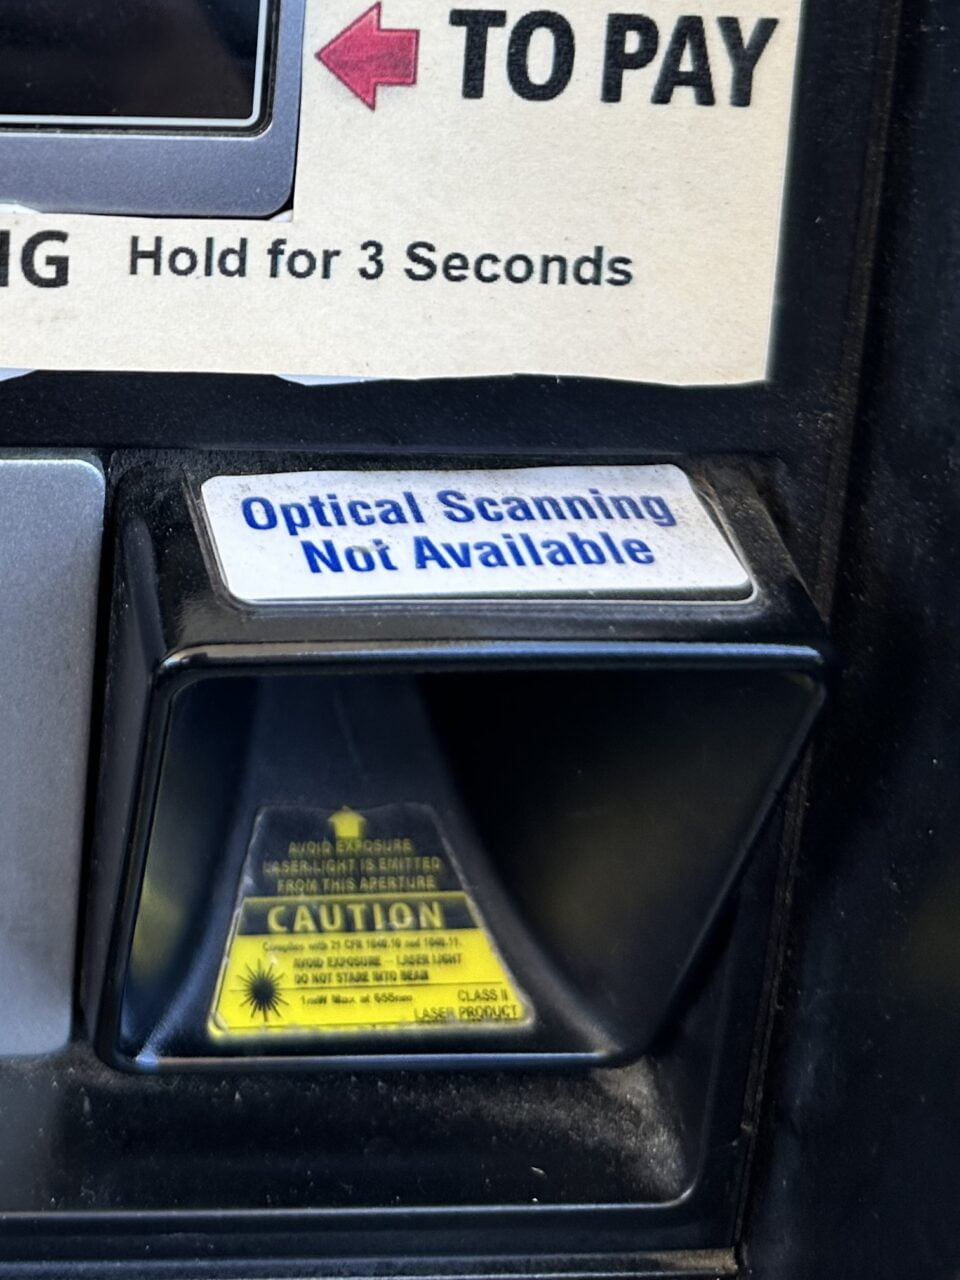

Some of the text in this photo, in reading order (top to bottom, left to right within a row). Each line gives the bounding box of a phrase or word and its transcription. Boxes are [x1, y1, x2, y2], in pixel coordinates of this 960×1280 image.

[449, 9, 779, 108] TO PAY
[129, 235, 634, 286] Hold for 3 Seconds
[241, 488, 677, 536] Optical Scanning
[301, 531, 656, 574] Not Available
[288, 838, 414, 856] AVOID EXPOSURE
[360, 856, 375, 870] IS
[379, 855, 442, 870] EMITTED
[277, 874, 437, 894] FROM THIS APERTURE
[266, 900, 445, 933] CAUTION
[327, 955, 381, 968] EXPOSURE
[311, 971, 332, 984] NOT
[336, 970, 369, 983] STARE
[457, 989, 498, 1002] CLASS
[458, 1004, 519, 1020] PRODUCT
